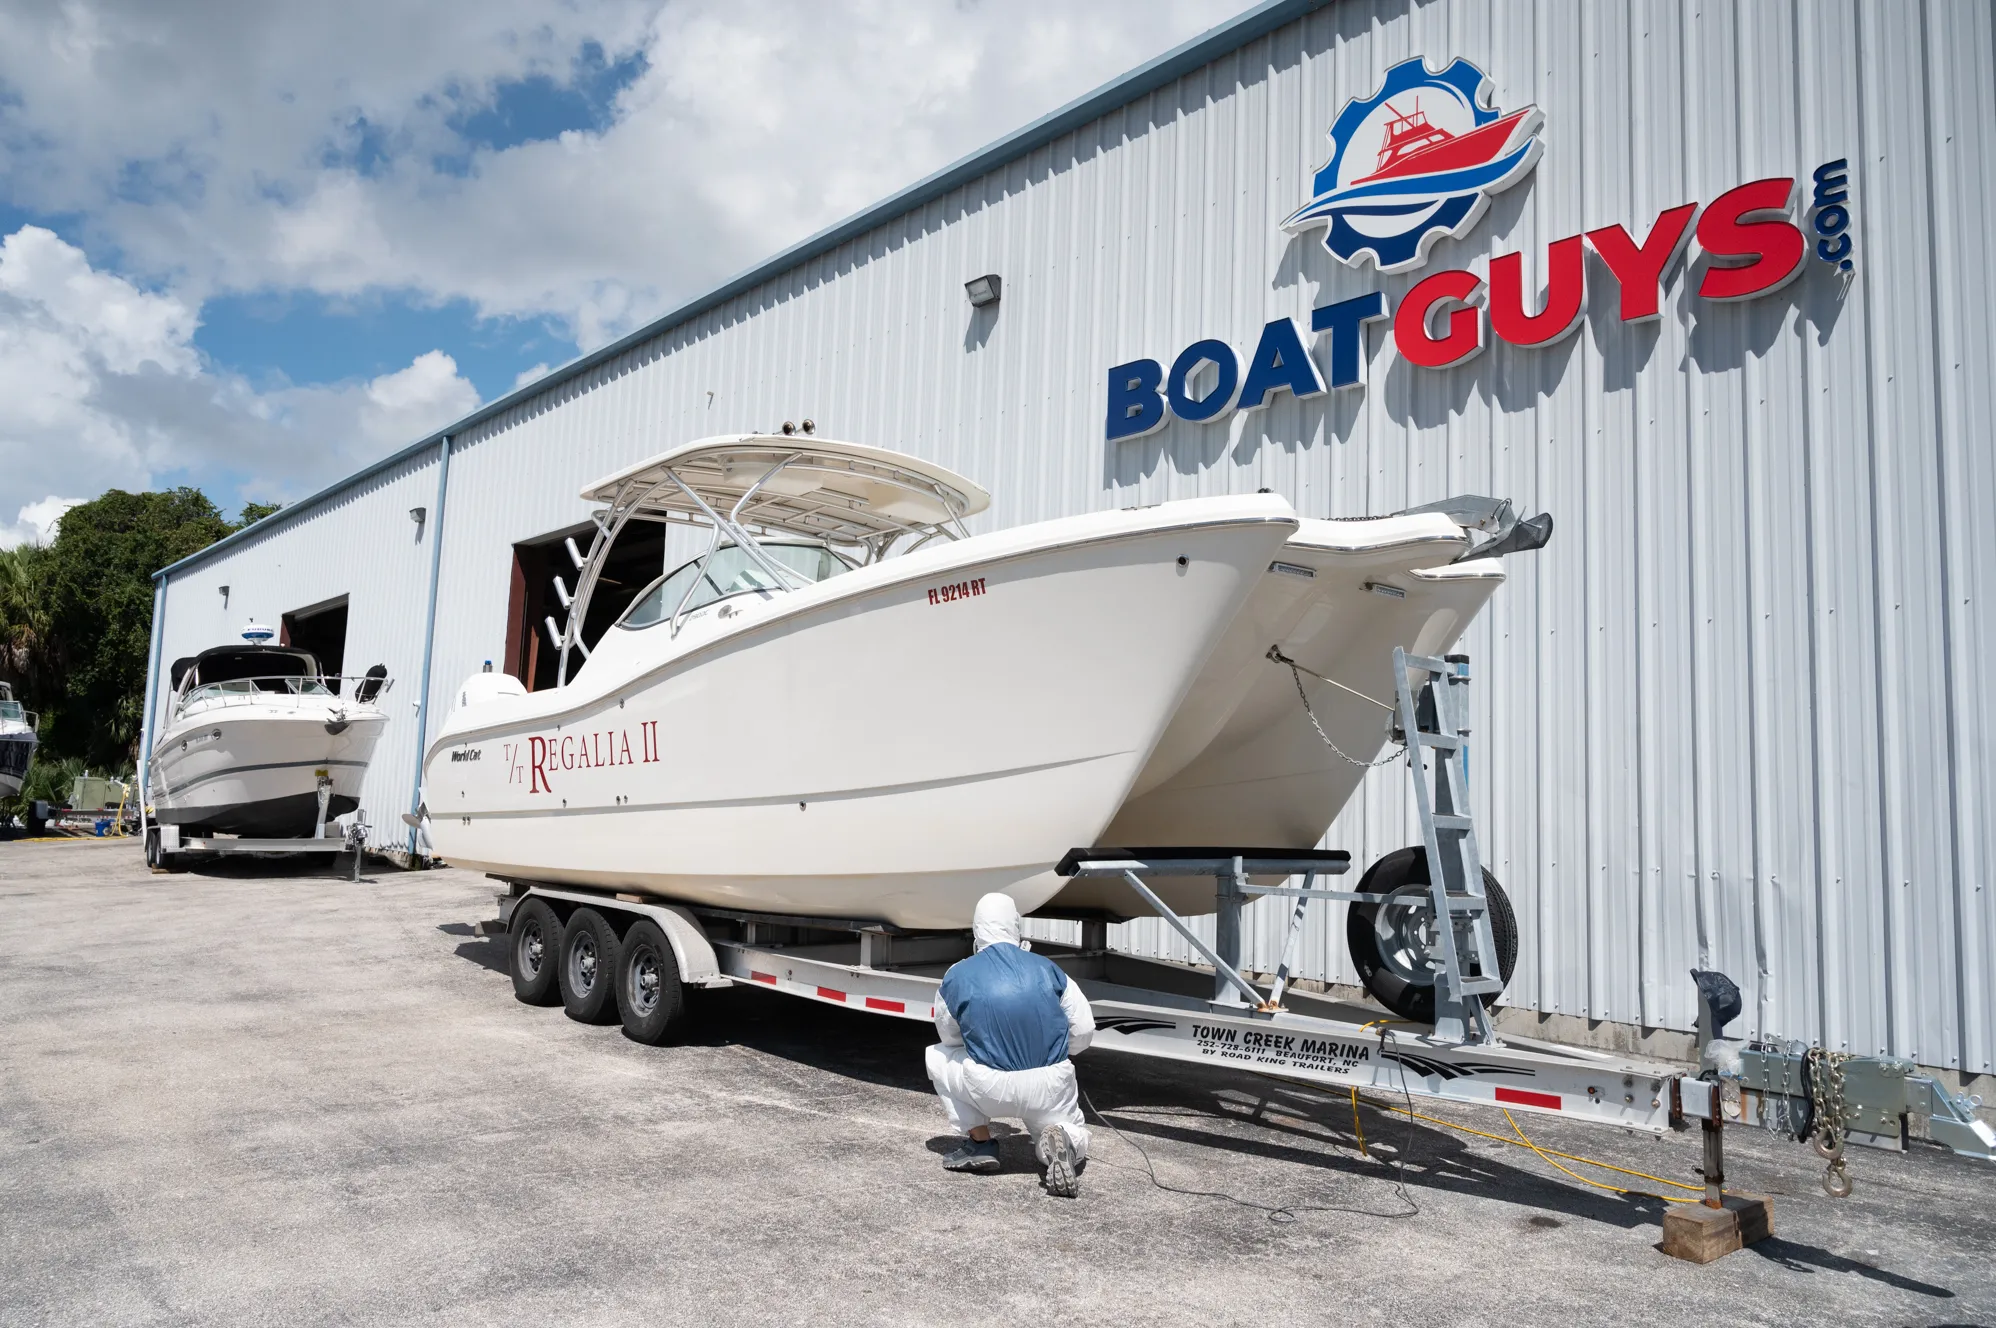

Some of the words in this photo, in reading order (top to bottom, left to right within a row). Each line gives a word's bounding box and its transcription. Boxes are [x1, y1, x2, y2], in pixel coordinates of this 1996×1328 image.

[1813, 158, 1853, 271] .com
[928, 588, 940, 605] FL
[941, 581, 970, 602] 9214
[971, 578, 986, 596] RT
[641, 720, 660, 763] II
[1192, 1025, 1237, 1042] TOWN
[1243, 1031, 1295, 1051] CREEK
[1300, 1039, 1369, 1060] MARINA
[1197, 1040, 1266, 1054] 252-728-6111
[1276, 1050, 1336, 1065] BEAUFORT,
[1342, 1059, 1359, 1067] NC
[1221, 1051, 1251, 1060] ROAD
[1257, 1056, 1286, 1065] KING
[1292, 1061, 1350, 1074] TRAILERS
